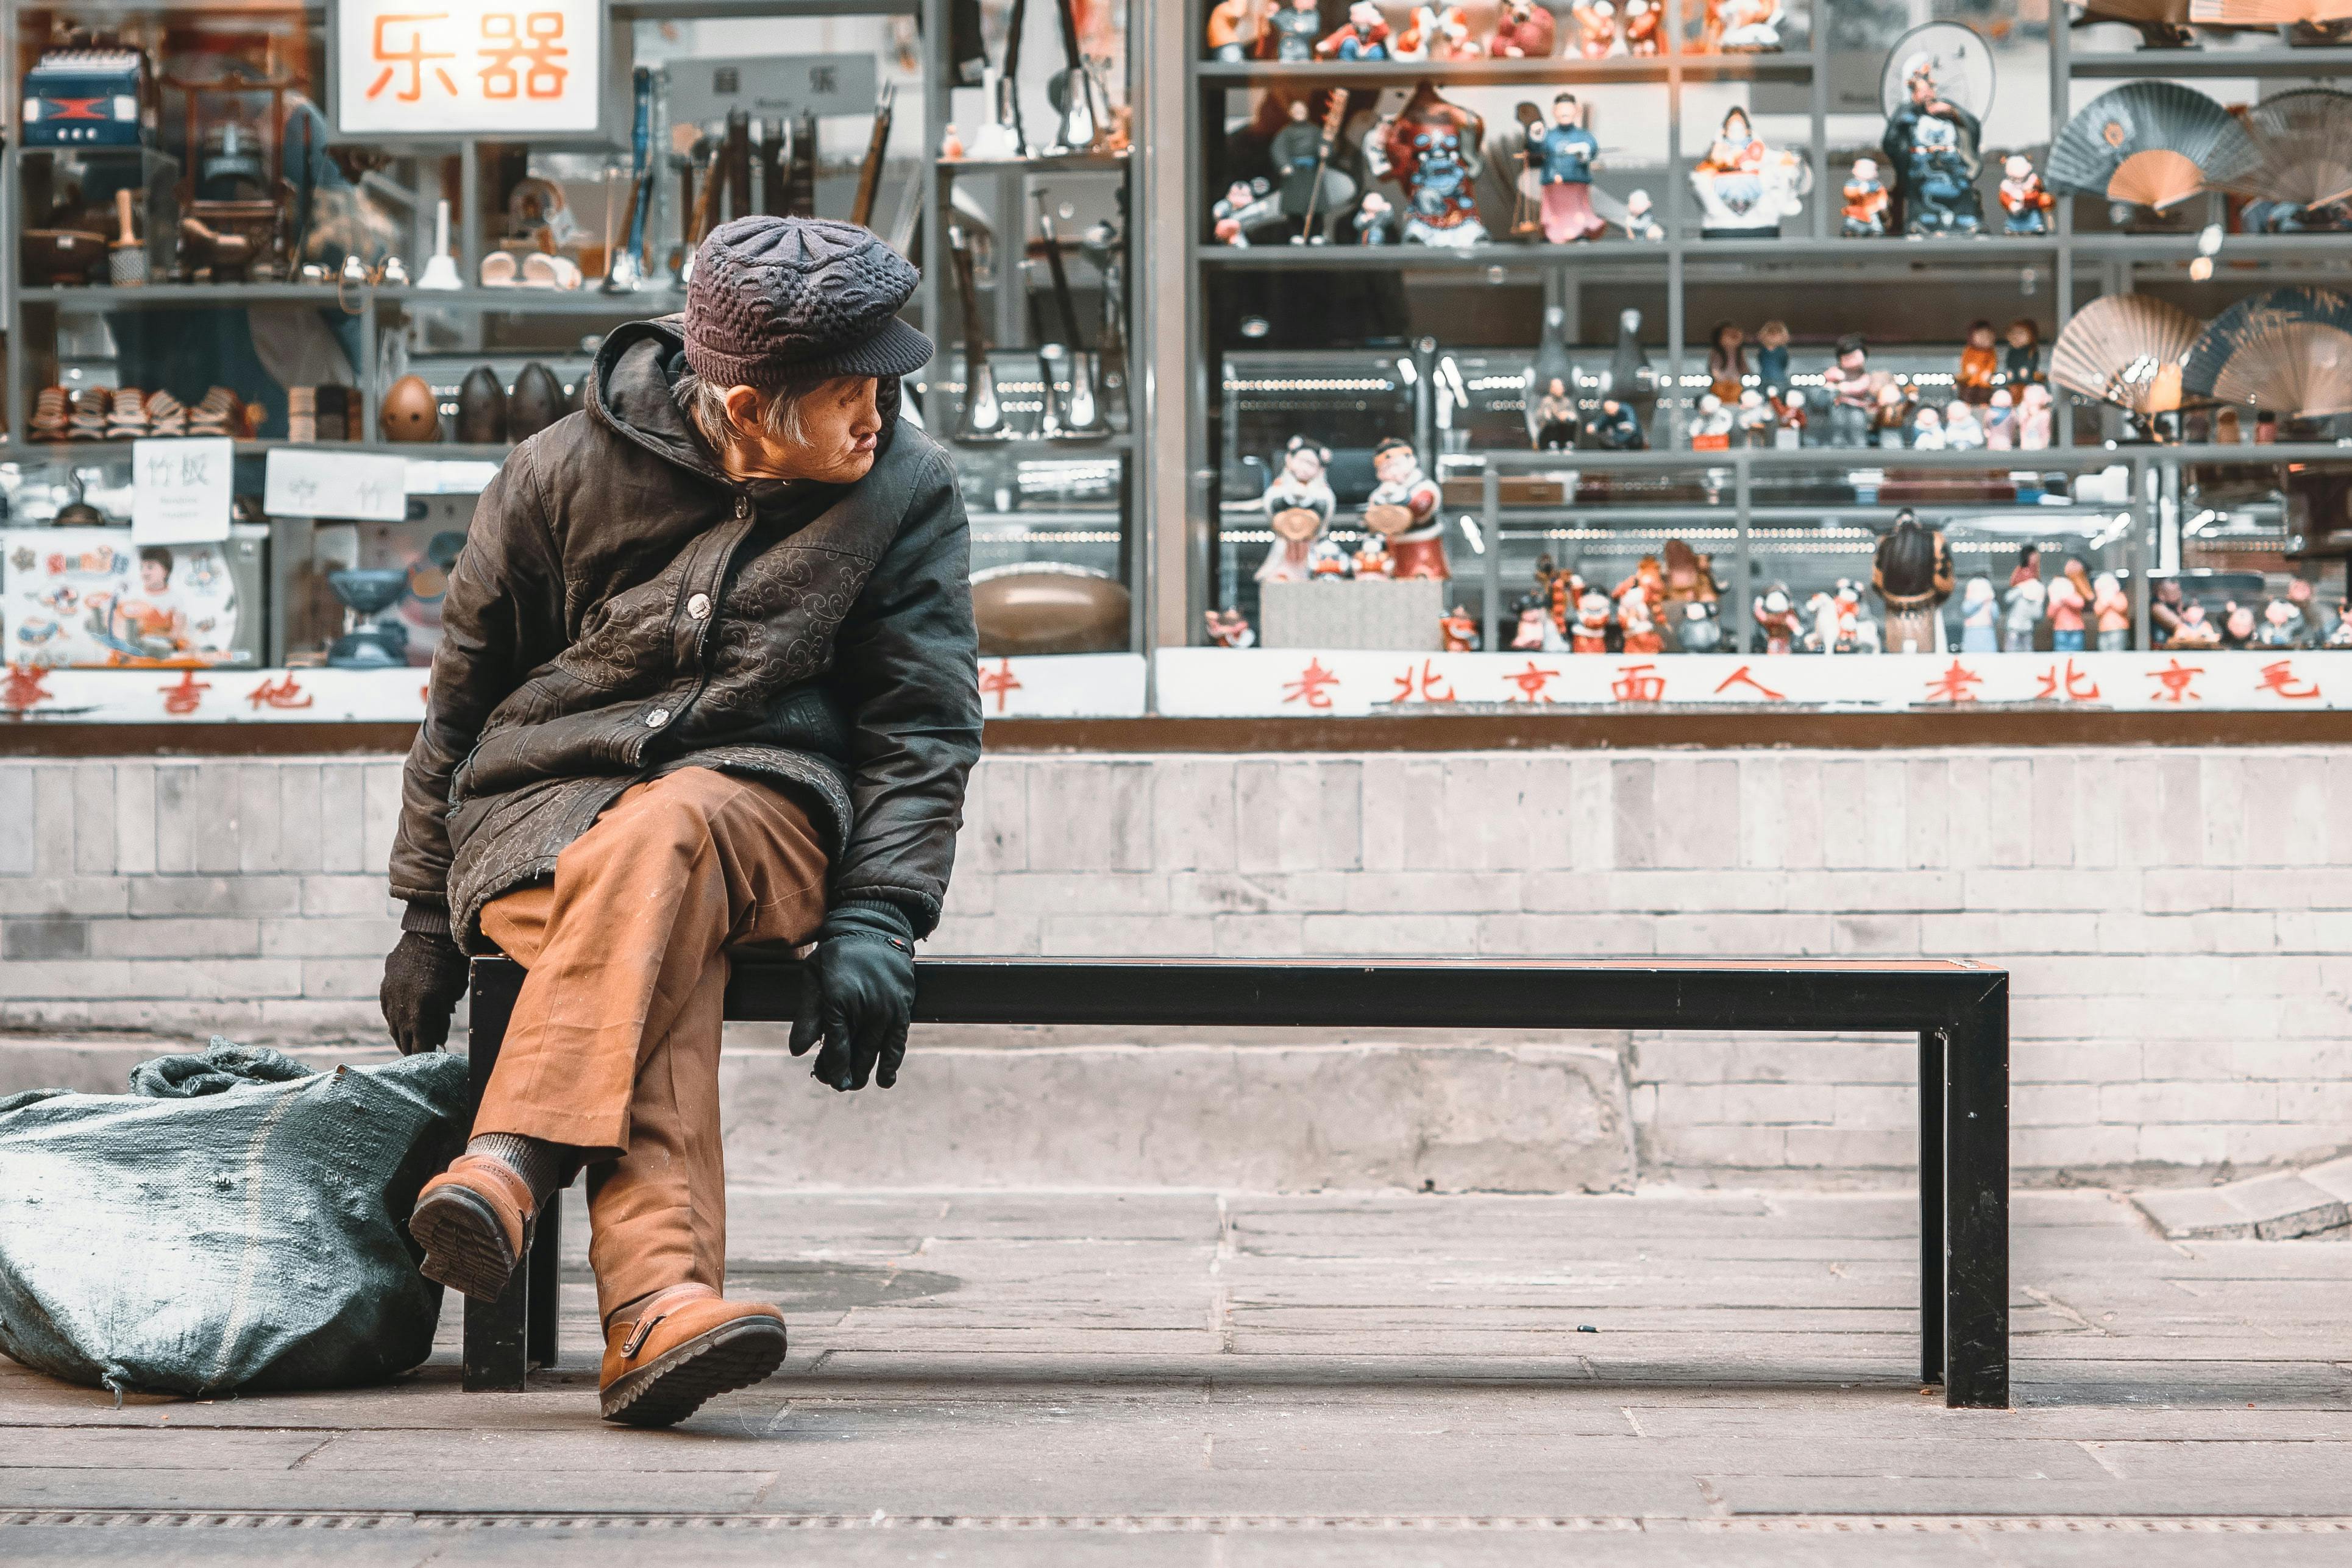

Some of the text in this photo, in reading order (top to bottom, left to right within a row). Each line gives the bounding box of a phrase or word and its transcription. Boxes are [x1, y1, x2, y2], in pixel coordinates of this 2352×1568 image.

[366, 12, 567, 101] 乐器
[146, 452, 210, 487] 竹板
[157, 670, 313, 714] 吉他
[978, 658, 1022, 712] 件
[1282, 657, 1786, 708] 老北京面人
[1925, 659, 2321, 702] 老北京毛
